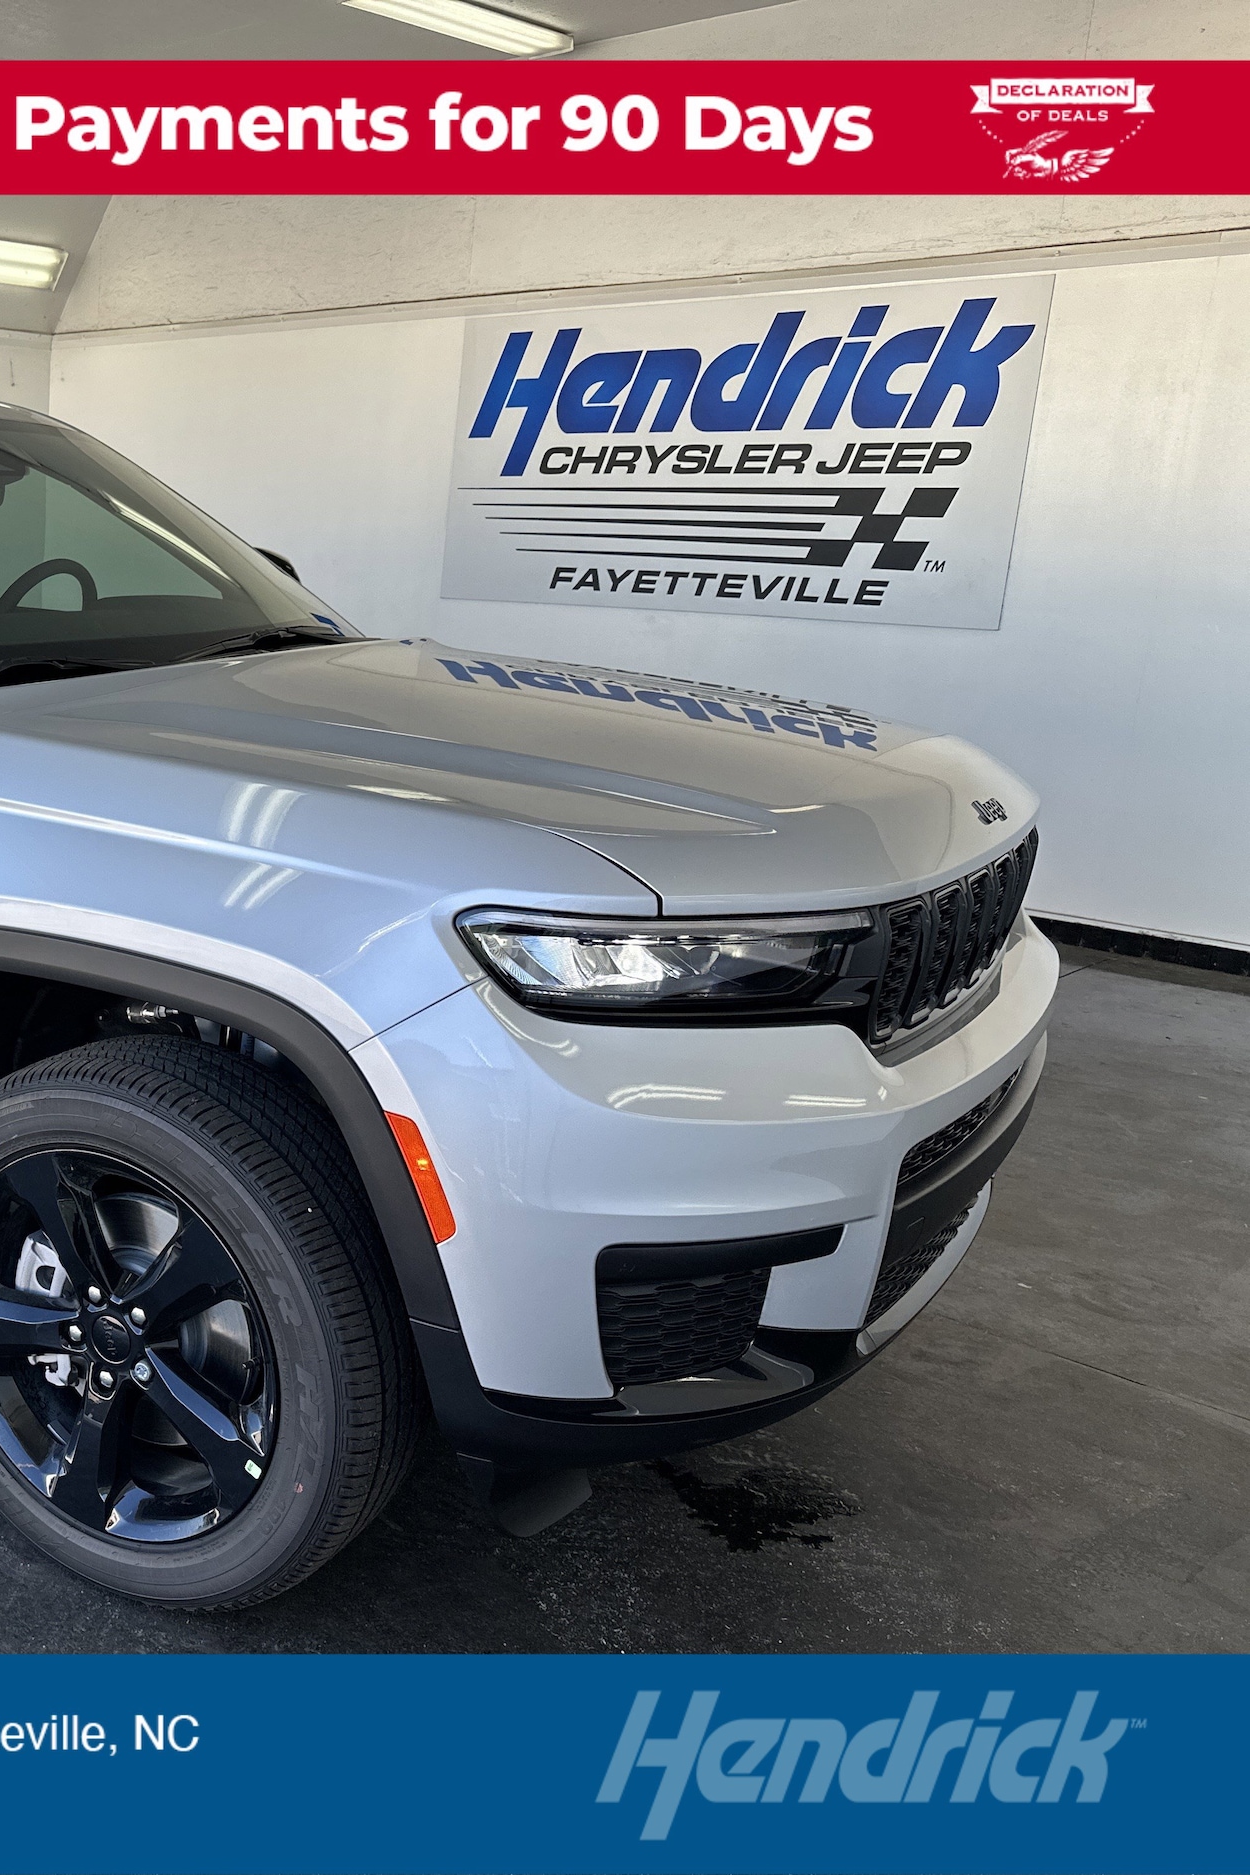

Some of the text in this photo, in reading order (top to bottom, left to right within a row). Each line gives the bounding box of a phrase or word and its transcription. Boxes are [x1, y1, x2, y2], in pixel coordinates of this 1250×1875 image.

[469, 297, 1035, 477] Hendrick
[538, 440, 972, 476] CHRYSLER JEEP
[549, 566, 890, 607] FAYETTEVILLE
